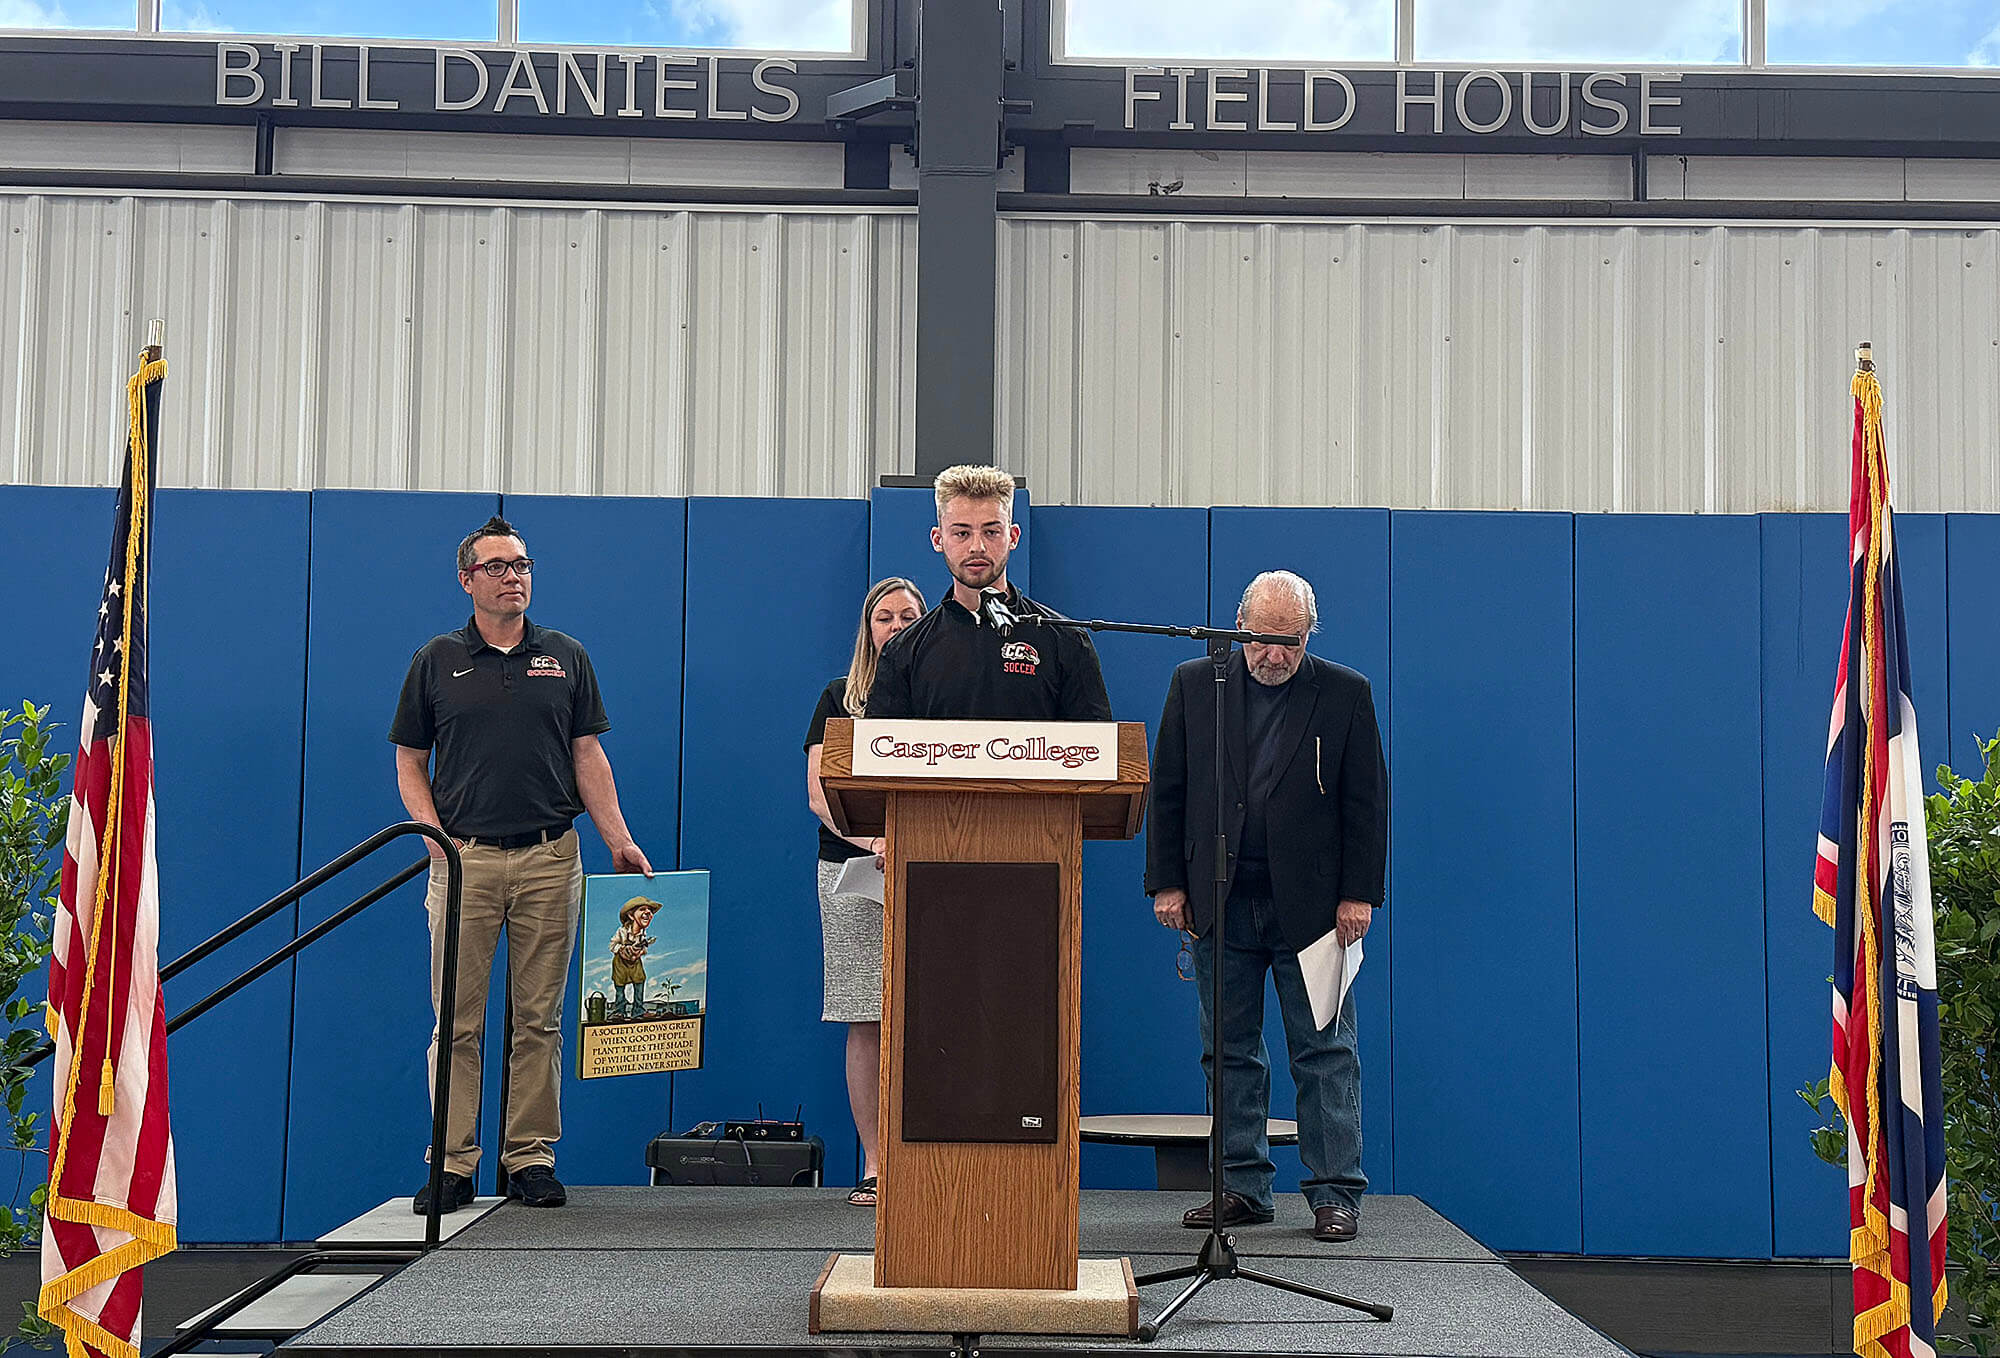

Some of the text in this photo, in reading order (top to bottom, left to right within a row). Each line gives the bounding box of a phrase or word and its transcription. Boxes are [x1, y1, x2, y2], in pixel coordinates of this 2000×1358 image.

[216, 42, 801, 123] BILL DANIELS
[1123, 67, 1684, 135] FIELD HOUSE
[1003, 661, 1036, 675] SOCCER
[870, 735, 1099, 768] Casper College
[592, 1021, 696, 1037] A SOCIETY GROWS GREAT
[600, 1031, 687, 1045] WHEN GOOD PEOPLE
[592, 1040, 694, 1056] PLANT TREES THE SHADE
[594, 1049, 692, 1065] OF WHICH THEY KNOW
[592, 1066, 615, 1075] THEY
[615, 1063, 637, 1072] WILL
[637, 1060, 666, 1070] NEVER
[666, 1060, 679, 1068] SIT
